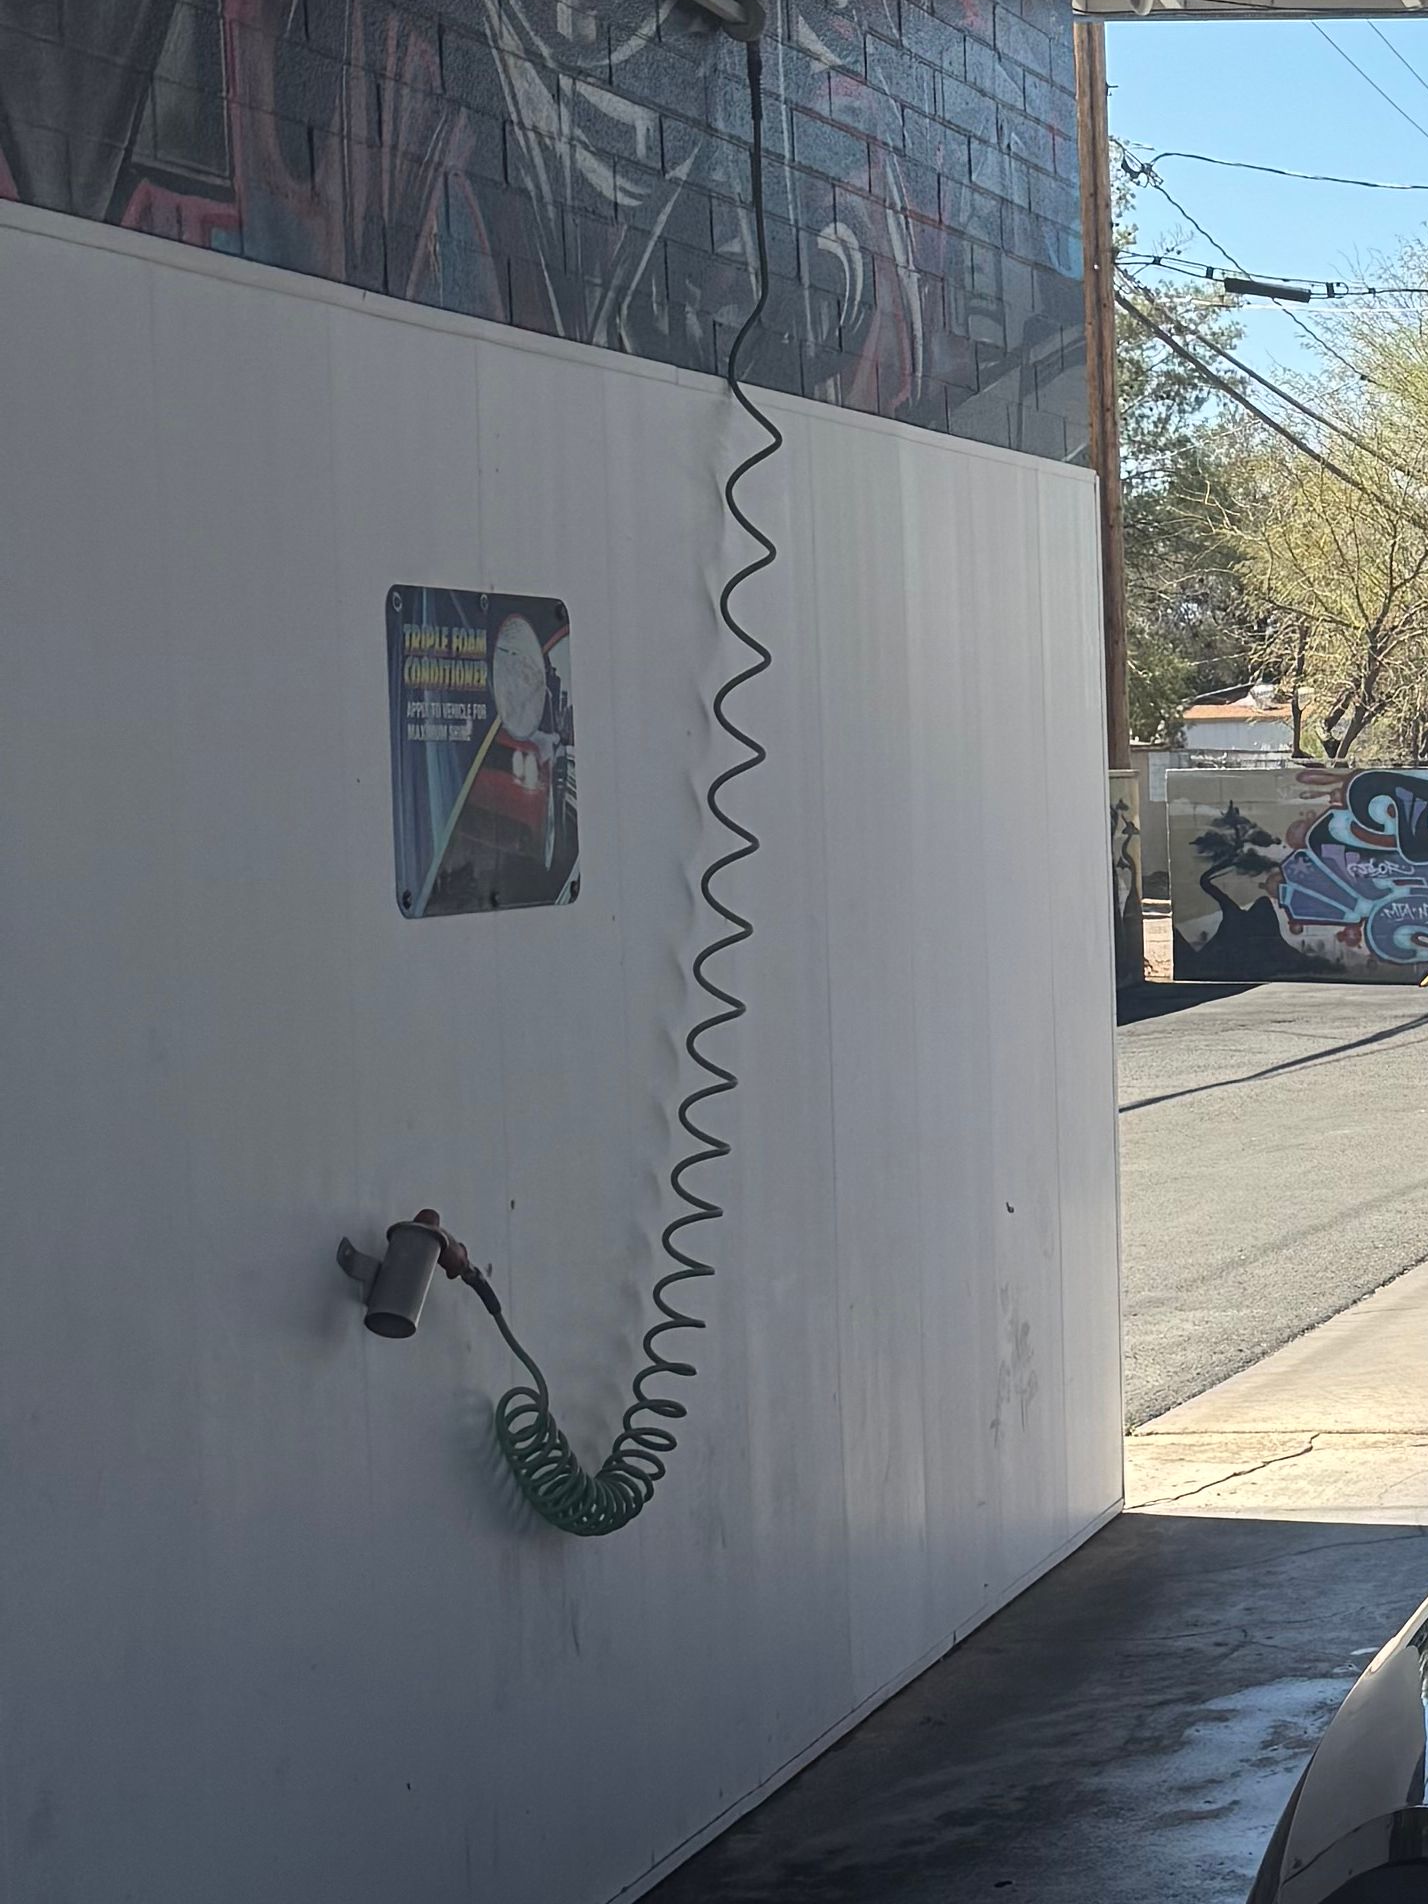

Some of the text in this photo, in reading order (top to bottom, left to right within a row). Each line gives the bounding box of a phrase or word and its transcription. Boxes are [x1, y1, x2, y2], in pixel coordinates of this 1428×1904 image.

[403, 623, 487, 656] TRIPLE FOAM
[404, 656, 488, 690] CONDITIONER
[442, 702, 472, 719] VEHICLE
[473, 703, 487, 720] FOR
